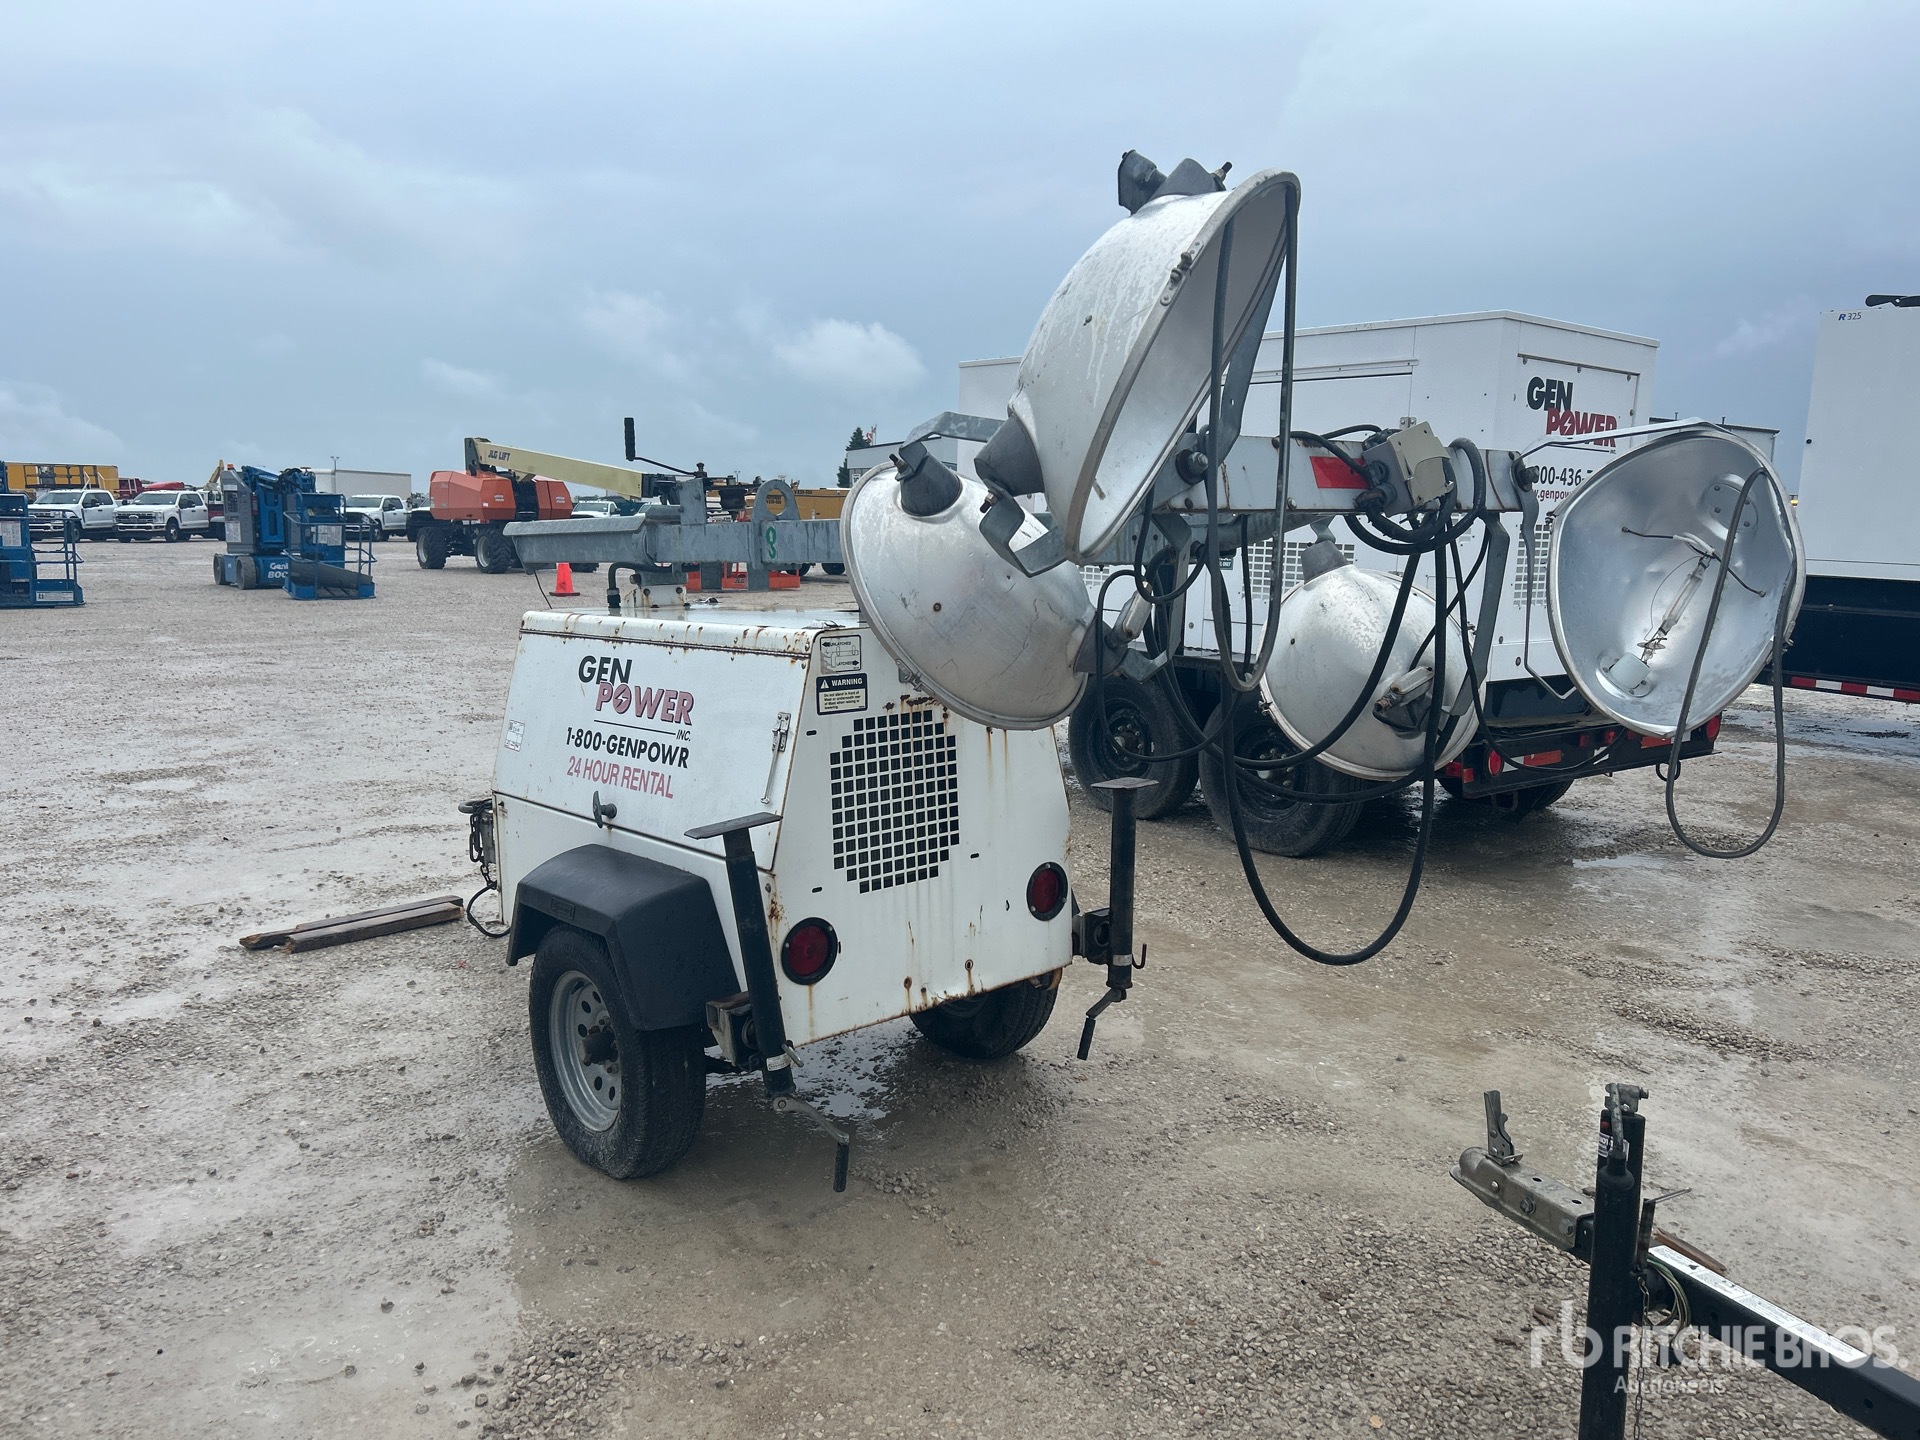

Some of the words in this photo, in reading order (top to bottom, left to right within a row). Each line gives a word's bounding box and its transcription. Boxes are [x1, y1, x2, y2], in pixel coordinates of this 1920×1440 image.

[1838, 313, 1846, 321] R
[1847, 312, 1862, 321] 325
[1527, 376, 1573, 413] GEN
[1546, 407, 1617, 448] POWER
[488, 450, 498, 459] JLG
[499, 451, 511, 462] LIFT
[578, 655, 633, 685] GEN
[831, 677, 863, 687] WARNING
[595, 681, 694, 726] POWER
[566, 727, 689, 769] 1-800-GENPOWR
[676, 729, 691, 742] INC.
[566, 755, 582, 778] 24
[582, 758, 620, 786] HOUR
[620, 765, 674, 799] RENTAL
